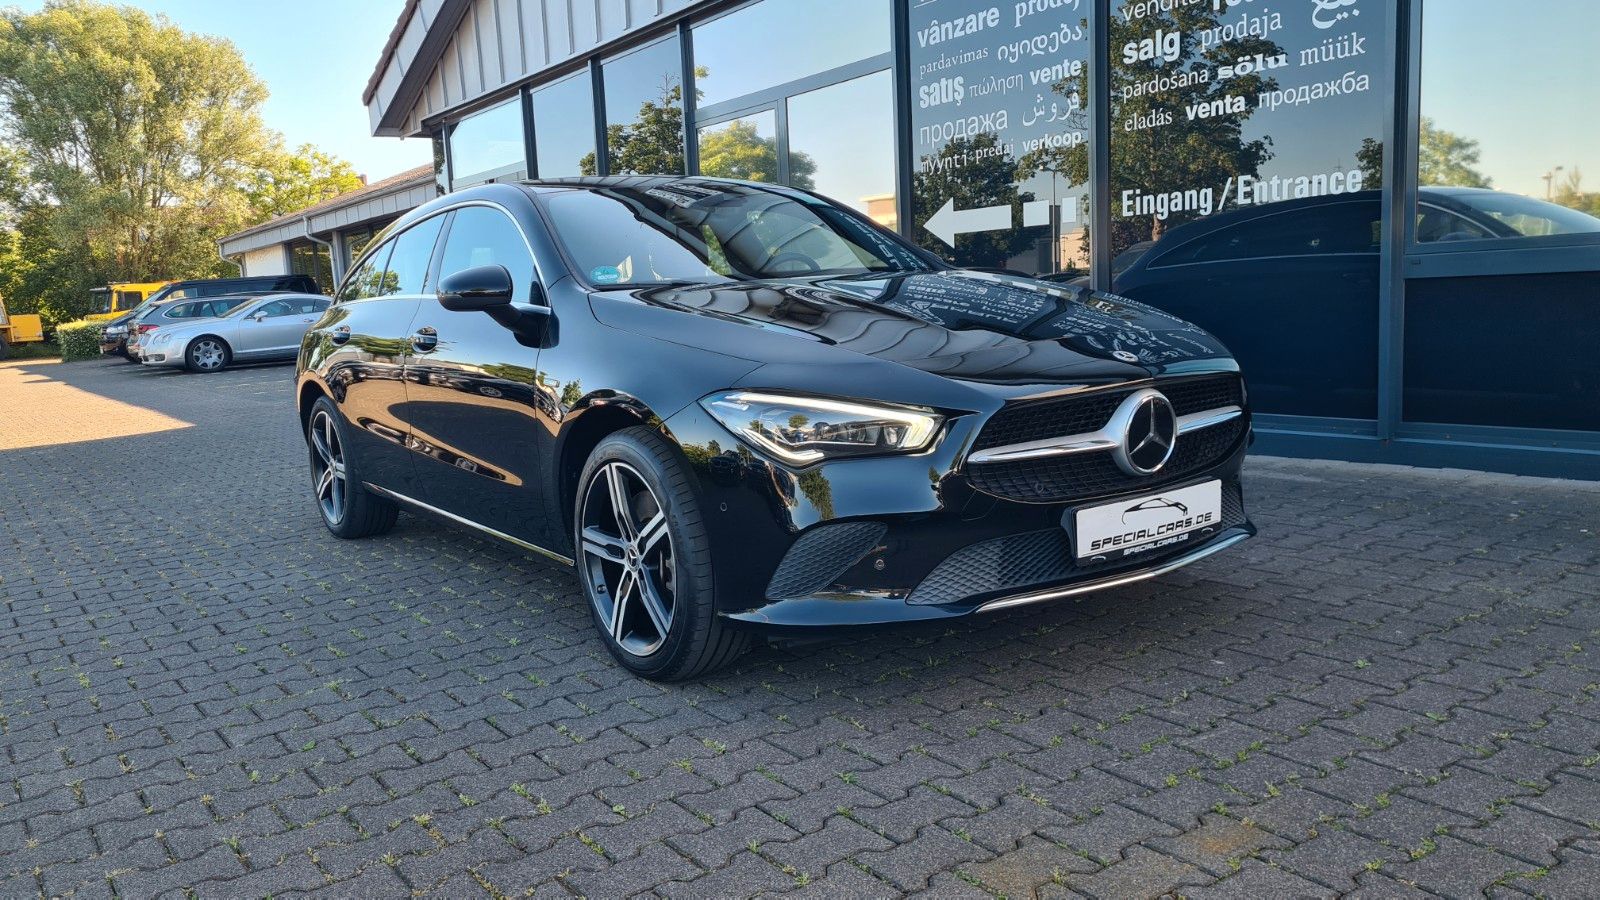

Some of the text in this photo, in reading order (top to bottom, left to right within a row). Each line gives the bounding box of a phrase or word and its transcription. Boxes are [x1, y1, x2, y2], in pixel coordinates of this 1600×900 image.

[917, 0, 1080, 48] vânzare pro
[1122, 0, 1199, 20] vend
[1122, 8, 1283, 64] salg prodaja
[919, 47, 989, 80] pardavimas
[1029, 58, 1082, 86] vente
[1123, 32, 1366, 103] pārdošana sölu müük
[919, 75, 965, 109] satış
[968, 73, 1024, 99] πώληση
[1022, 85, 1081, 127] فروش
[1259, 70, 1370, 112] продажба
[920, 109, 1008, 148] продажа
[1124, 94, 1246, 132] eladás venta
[921, 131, 1082, 176] myynti predaj verkoop
[1122, 187, 1213, 220] Eingang
[1237, 169, 1363, 206] Entrance
[1090, 511, 1212, 551] SPECIALCARS.DE
